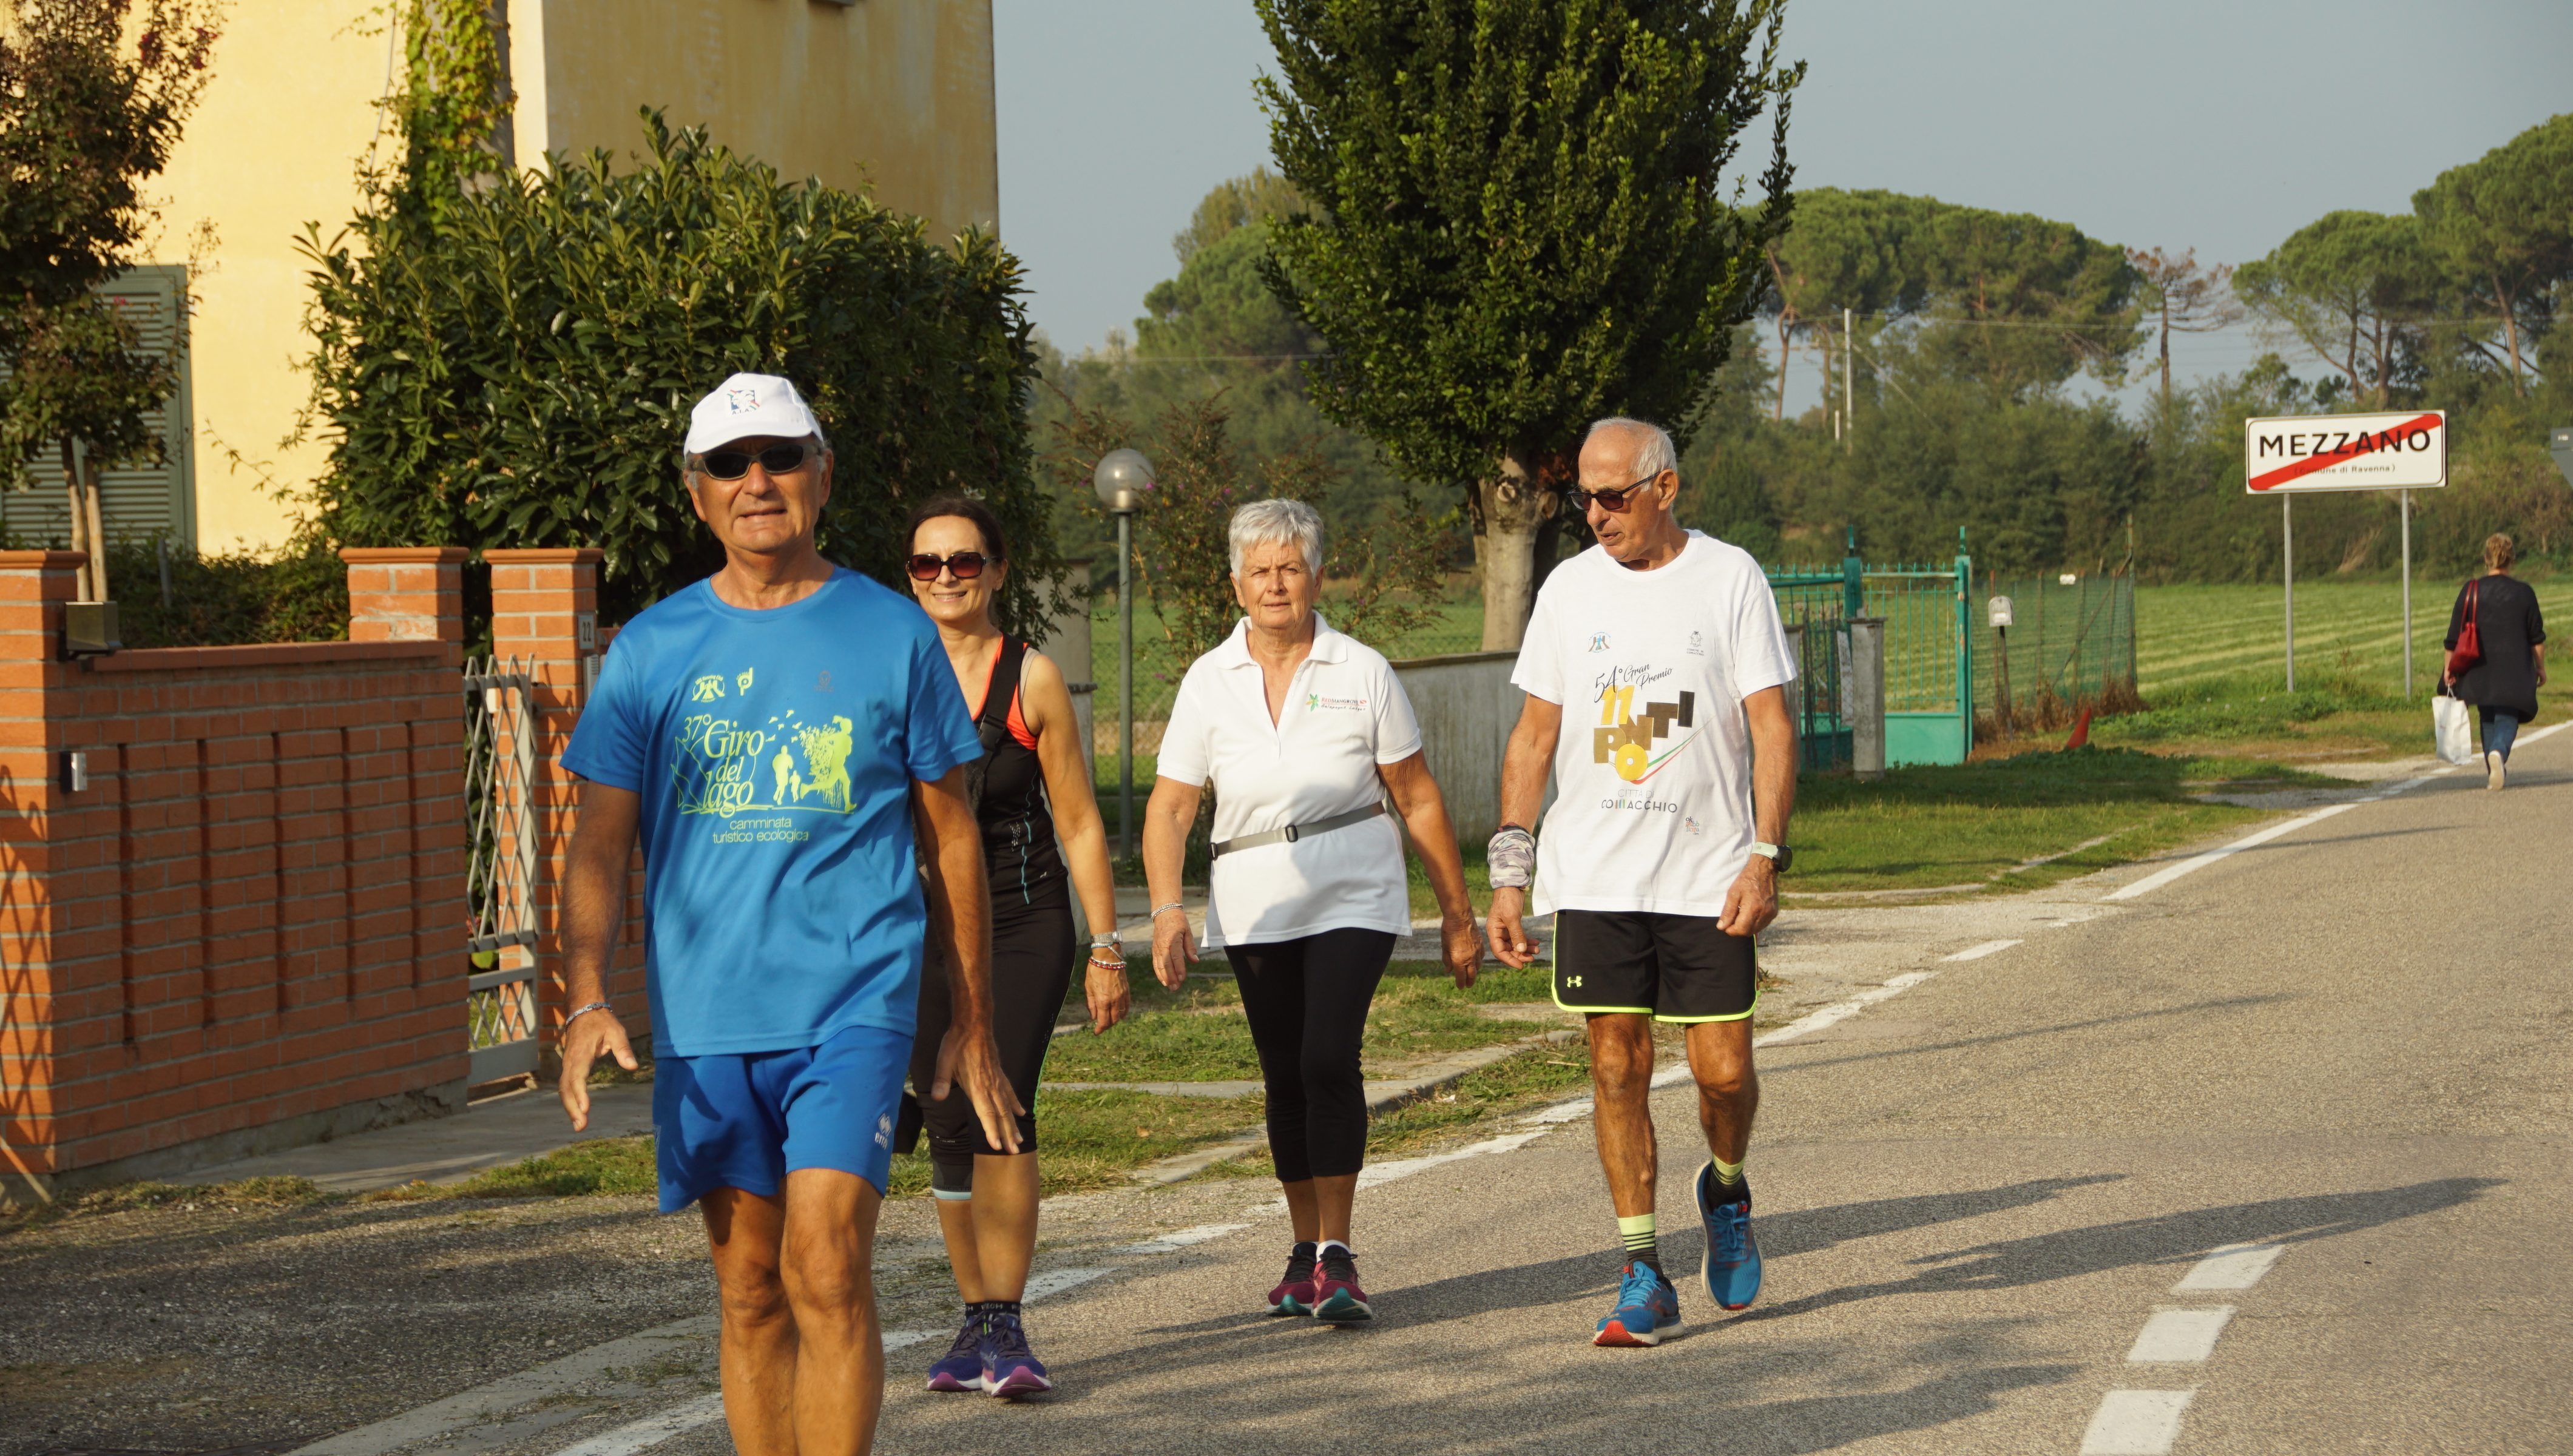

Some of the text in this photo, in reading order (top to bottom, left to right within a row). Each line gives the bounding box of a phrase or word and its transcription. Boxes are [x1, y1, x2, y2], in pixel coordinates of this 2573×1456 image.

[2259, 429, 2430, 457] MEZZANO
[1624, 664, 1651, 682] Gran
[1636, 667, 1673, 690] Premio
[1601, 685, 1634, 725] 11
[704, 719, 764, 758] Giro
[715, 756, 745, 782] del
[702, 770, 754, 818] lago
[1646, 790, 1655, 799] DI
[729, 816, 792, 831] camminata
[712, 828, 809, 844] turistico ecologica
